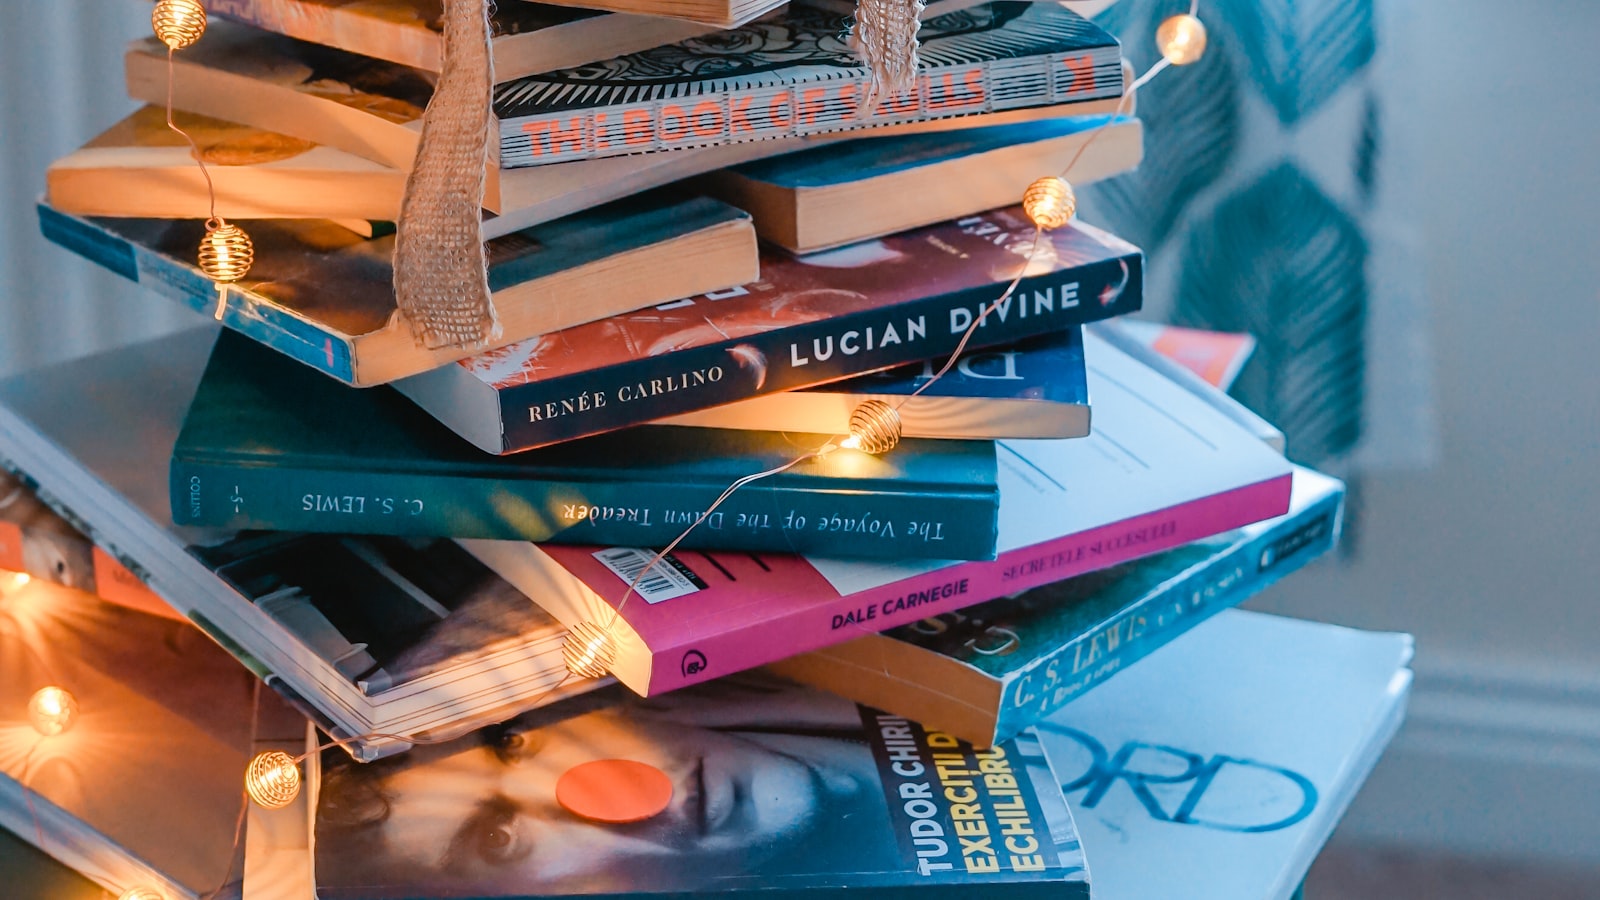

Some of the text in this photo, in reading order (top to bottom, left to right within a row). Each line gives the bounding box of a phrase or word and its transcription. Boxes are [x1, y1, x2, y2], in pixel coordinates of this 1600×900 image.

[522, 112, 609, 158] THE
[622, 95, 756, 146] BOOK
[769, 88, 825, 129] OF
[789, 281, 1081, 368] LUCIAN DIVINE
[527, 365, 724, 423] RENÉE CARLINO
[301, 493, 367, 514] LEWIS
[817, 510, 896, 538] Voyage
[907, 520, 945, 542] The
[831, 577, 970, 631] DALE CARNEGIE
[898, 781, 954, 877] TUDOR
